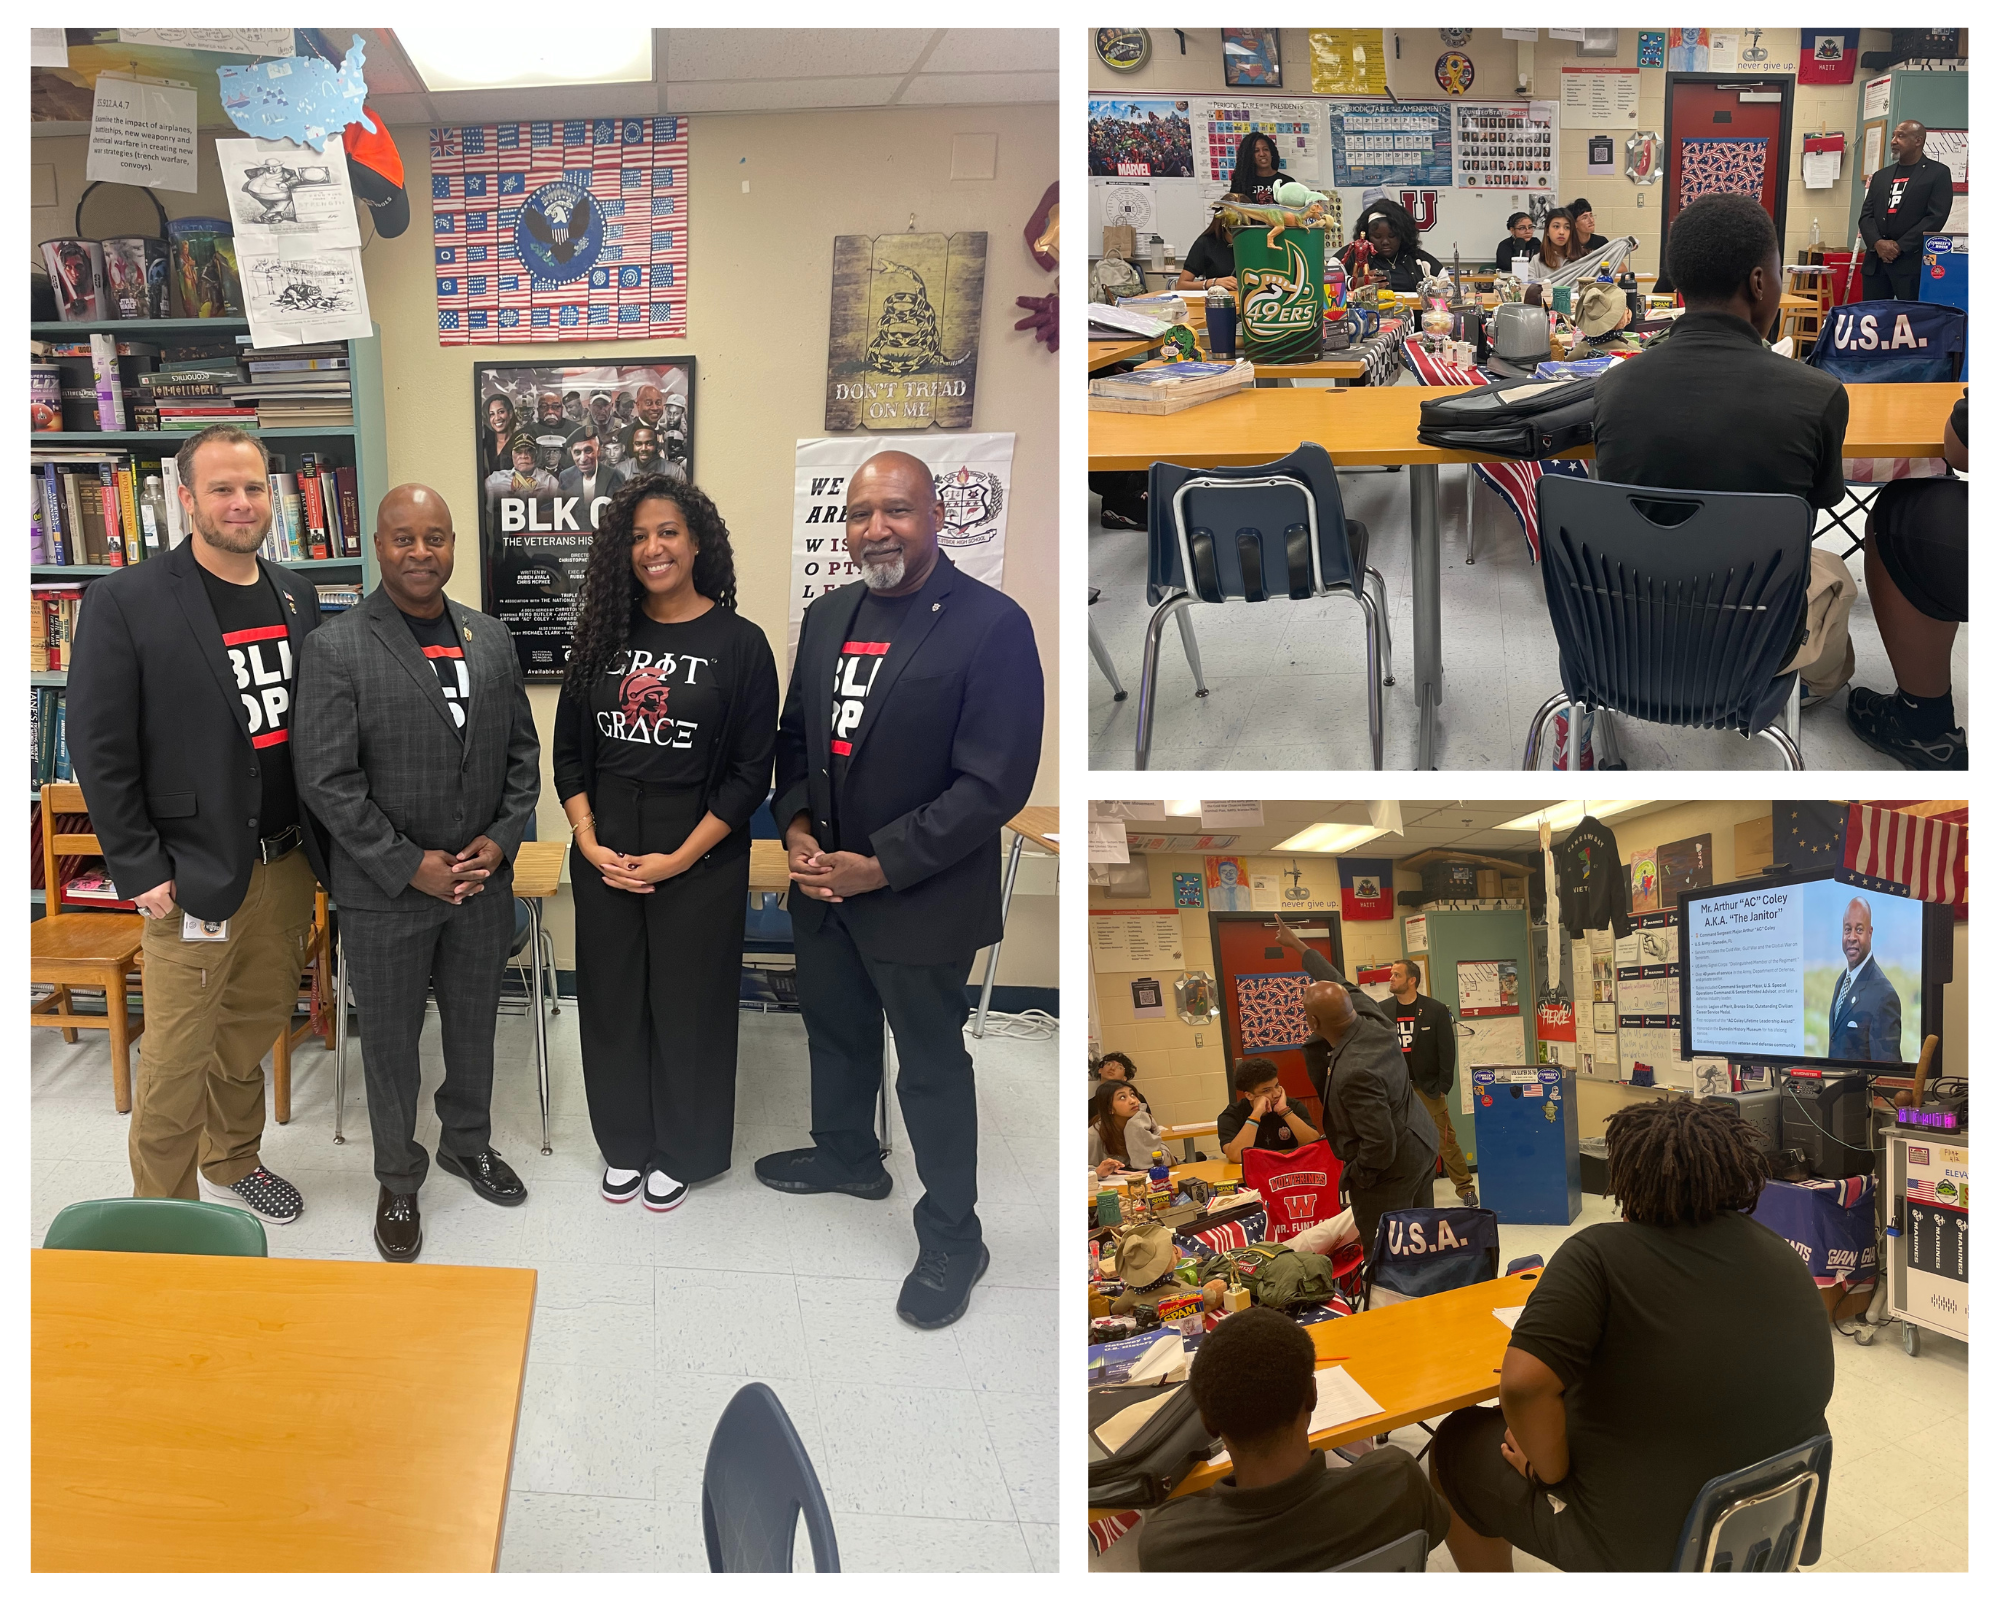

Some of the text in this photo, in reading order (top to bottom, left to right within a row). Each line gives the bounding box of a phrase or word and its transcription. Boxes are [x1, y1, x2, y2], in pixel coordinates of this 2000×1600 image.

[1763, 61, 1780, 71] give
[1784, 63, 1796, 71] up.
[1214, 101, 1240, 109] PERIODIC
[125, 118, 148, 128] impact
[159, 124, 192, 134] airplanes,
[141, 133, 176, 143] weaponry
[114, 139, 140, 148] warfare
[150, 144, 177, 154] creating
[135, 151, 159, 161] (trench
[161, 155, 189, 165] warfare,
[120, 161, 153, 171] convoys).
[1117, 163, 1150, 176] MARVEL
[1400, 190, 1438, 232] U
[1245, 302, 1313, 322] 49ERS
[1834, 314, 1928, 351] U.S.A.
[836, 380, 967, 400] DON'T TREAD
[870, 402, 931, 419] ON ME
[810, 477, 844, 496] WE
[125, 502, 134, 531] HISTORY
[501, 497, 580, 532] BLK
[503, 537, 522, 546] THE
[524, 536, 576, 546] VETERANS
[1308, 900, 1324, 909] give
[1701, 894, 1788, 914] Mr. Arthur “AC” Coley
[1705, 908, 1783, 927] A.K.A. “The Janitor”
[1653, 979, 1667, 991] SPAM
[1270, 1172, 1326, 1192] WOLVERINES
[1152, 1196, 1170, 1204] SPAM
[1284, 1194, 1317, 1219] W
[1292, 1221, 1315, 1232] FLINT
[1388, 1220, 1469, 1256] U.S.A.
[1159, 1304, 1180, 1316] 2-PACK
[1164, 1304, 1198, 1322] SPAM
[1105, 1339, 1141, 1348] Gateway
[1122, 1340, 1153, 1349] History
